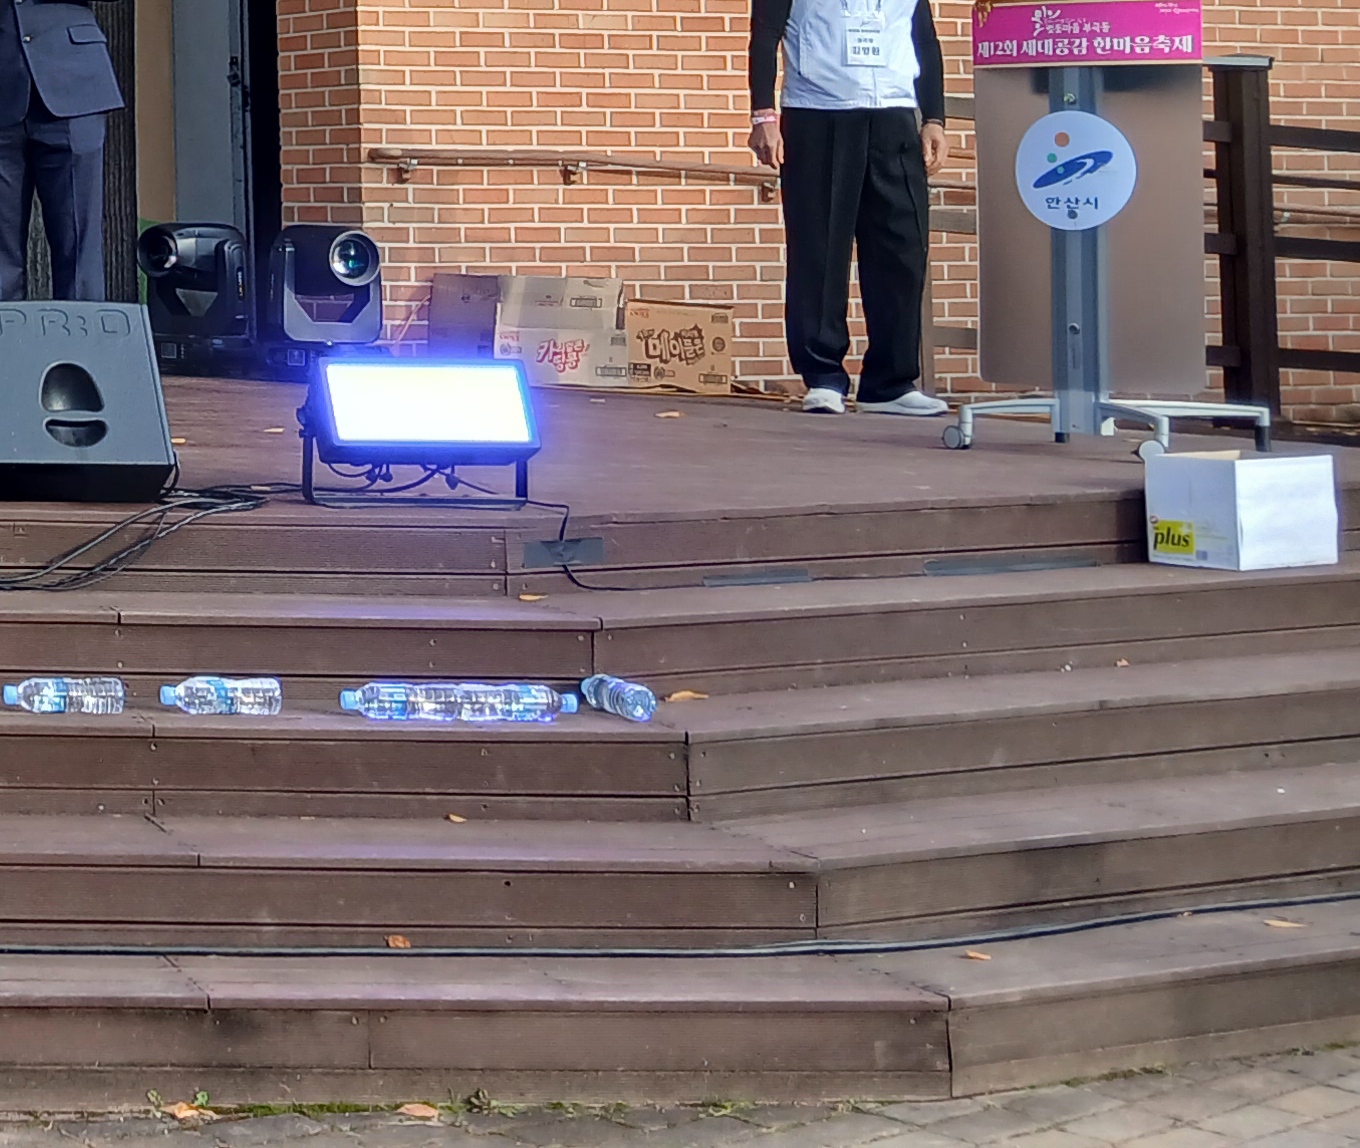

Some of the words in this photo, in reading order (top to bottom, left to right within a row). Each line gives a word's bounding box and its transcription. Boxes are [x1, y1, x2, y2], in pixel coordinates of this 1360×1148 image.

[977, 40, 1017, 58] 제12회
[1020, 37, 1090, 56] 세대공감
[1092, 34, 1194, 55] 한마음축제
[1044, 196, 1099, 210] 안산시
[1153, 526, 1190, 550] plus
